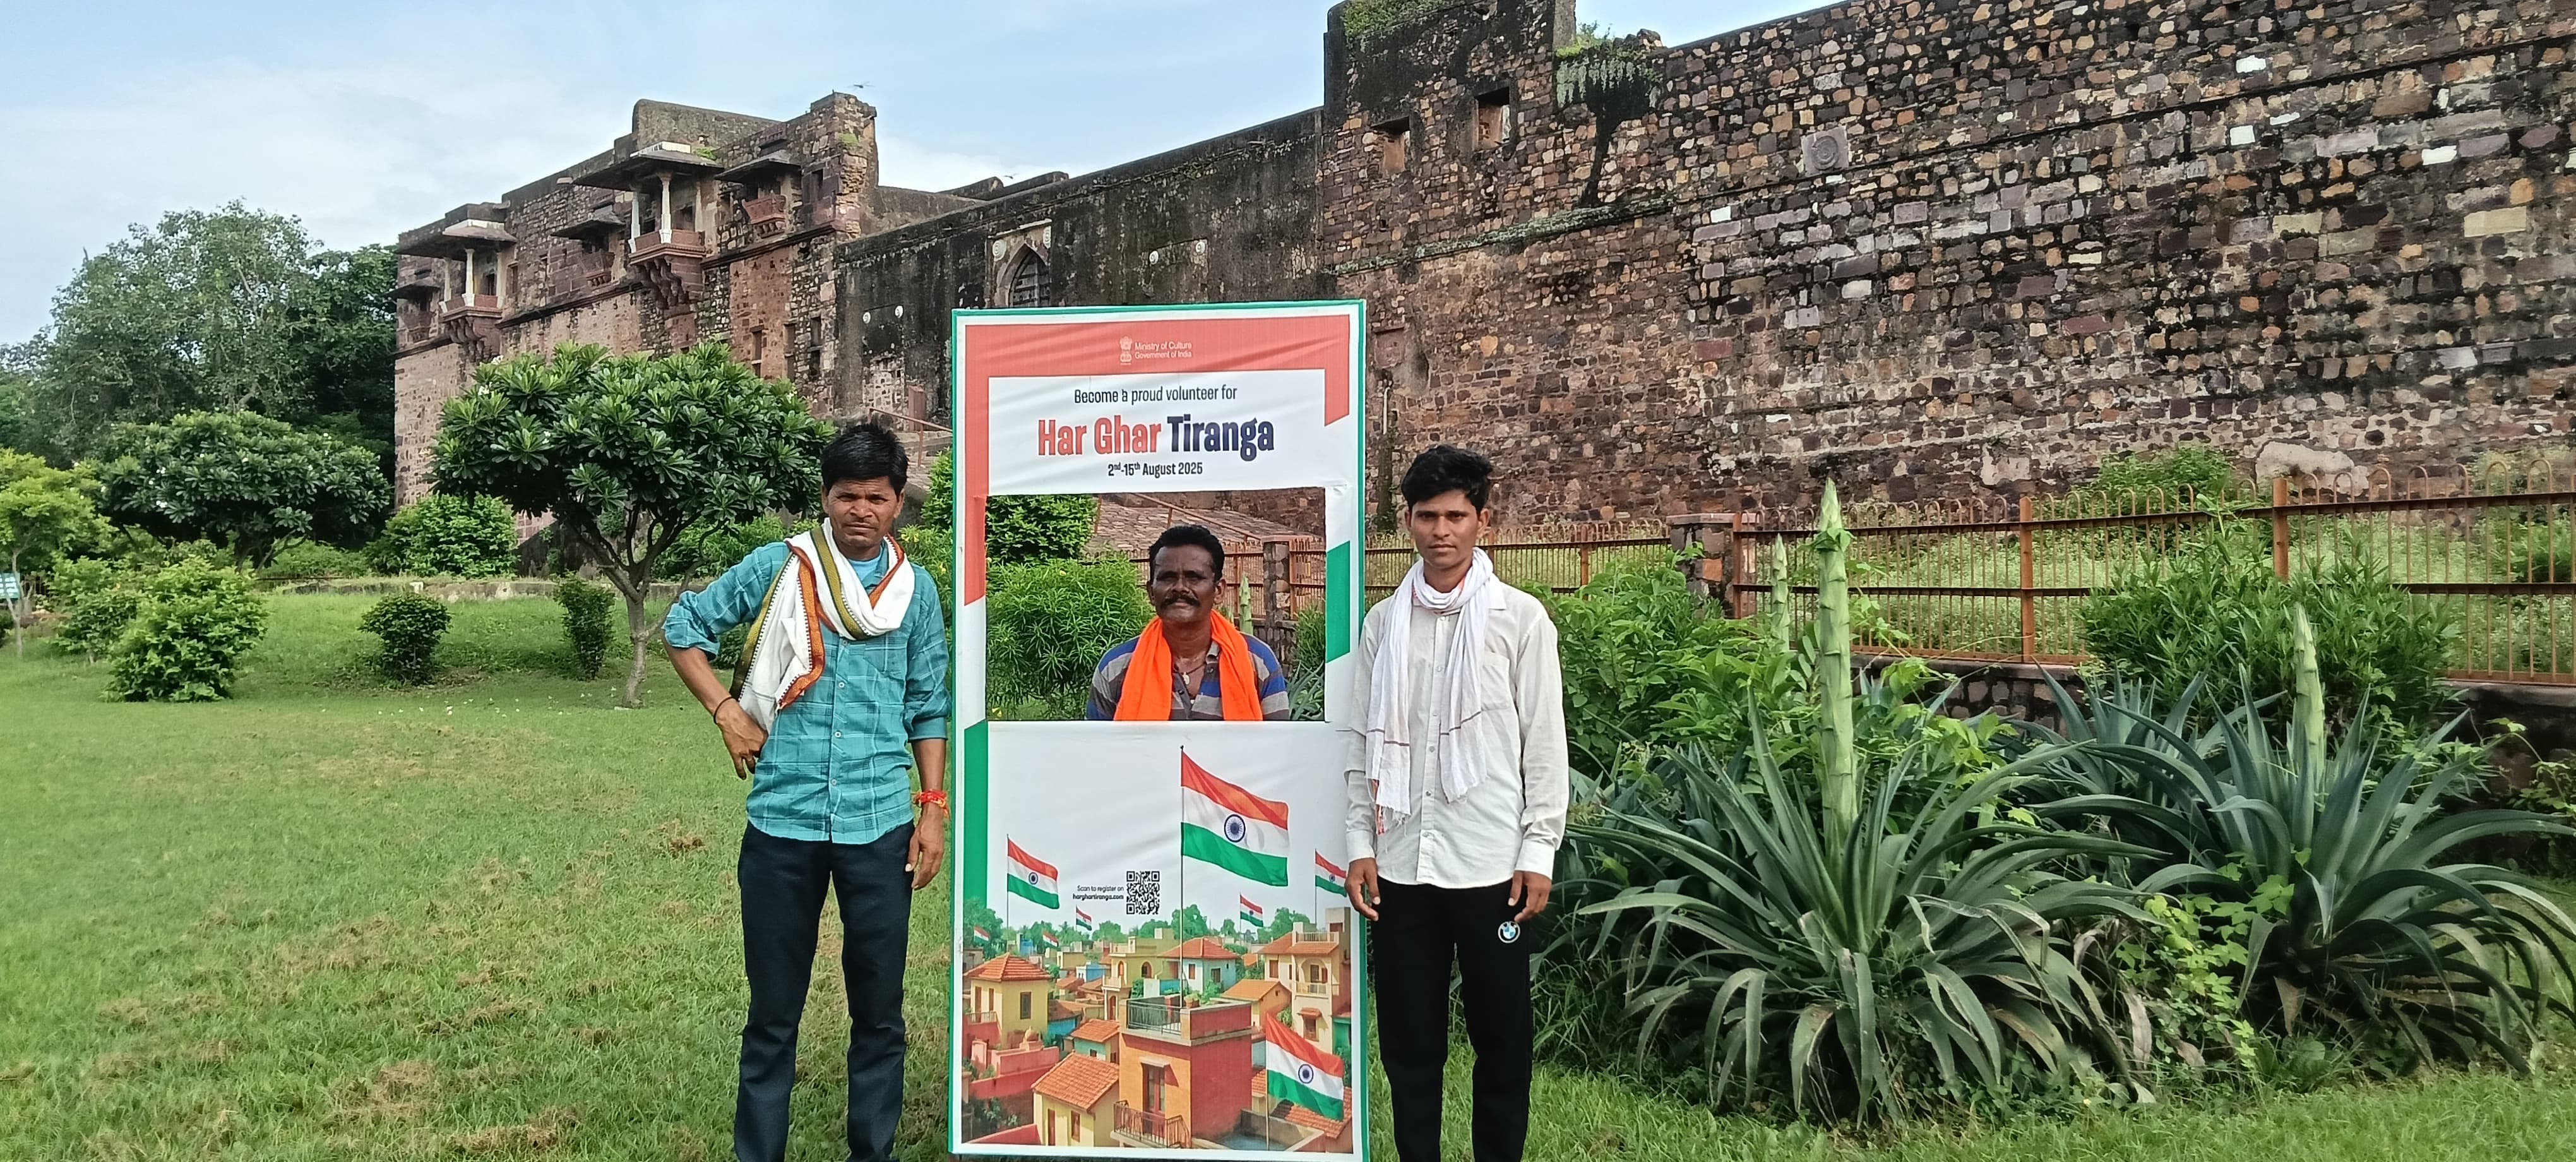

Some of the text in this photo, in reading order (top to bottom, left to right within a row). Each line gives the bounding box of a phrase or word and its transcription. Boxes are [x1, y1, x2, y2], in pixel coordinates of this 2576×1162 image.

[1135, 341, 1192, 351] Ministry of Culture
[1135, 350, 1169, 359] Government
[1075, 384, 1237, 405] Become a proud volunteer for
[1038, 414, 1275, 462] Har Ghar Tiranga
[1143, 462, 1176, 479] August
[1178, 462, 1203, 474] 2025
